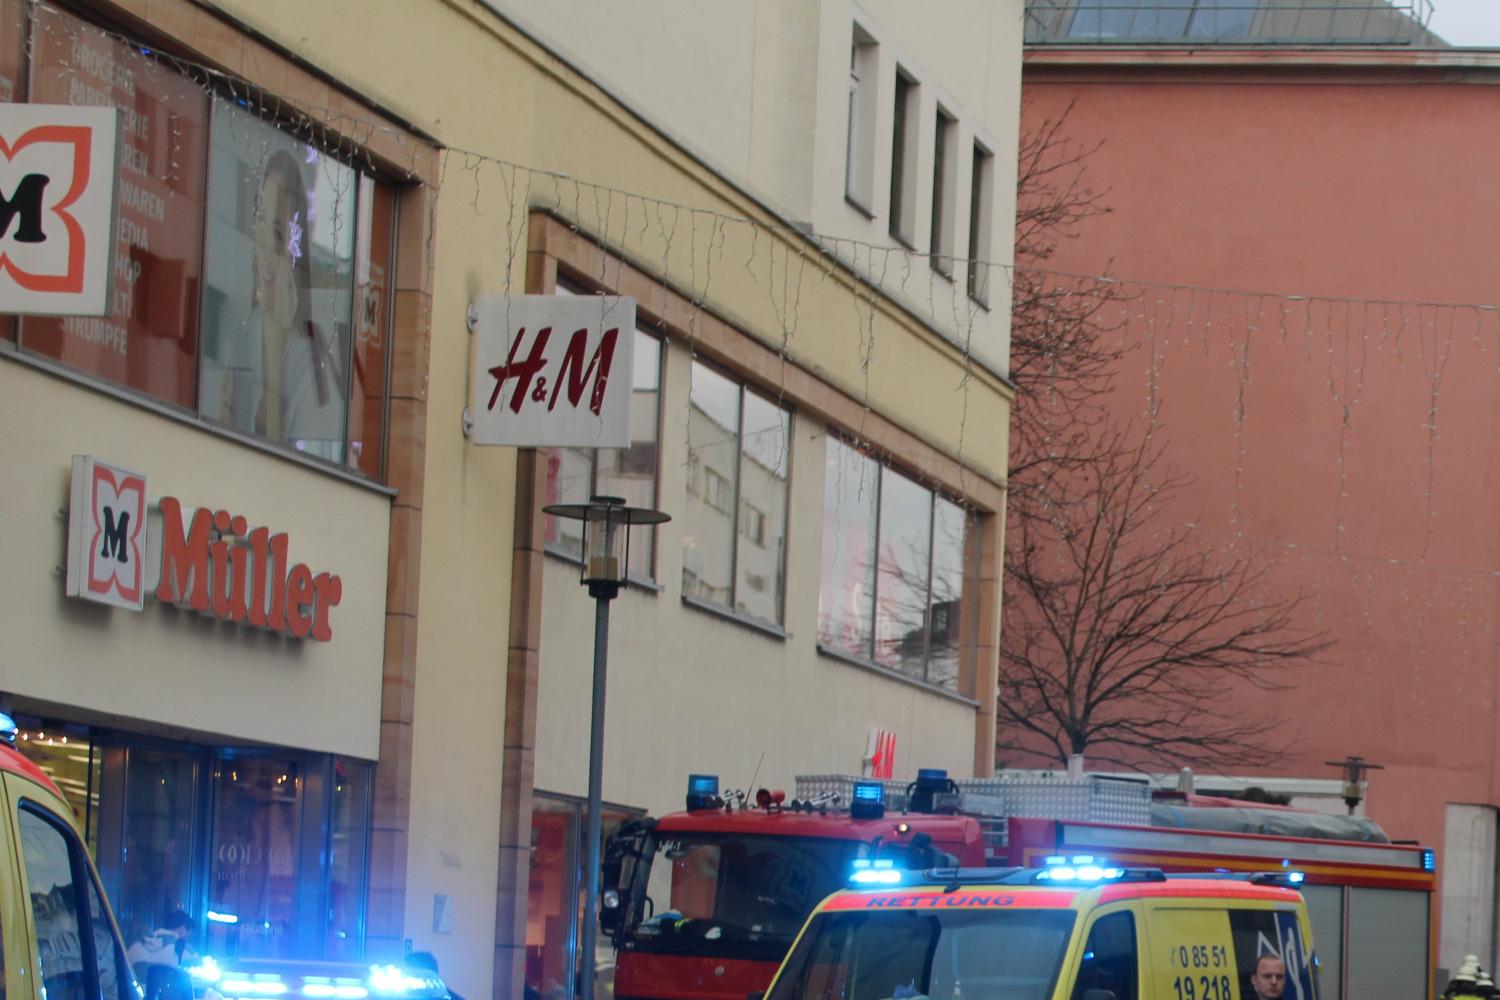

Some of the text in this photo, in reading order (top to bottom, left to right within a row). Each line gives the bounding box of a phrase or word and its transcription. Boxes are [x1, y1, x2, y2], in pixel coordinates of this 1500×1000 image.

[487, 326, 619, 416] H&M
[101, 505, 130, 563] M
[156, 496, 342, 641] Müller
[866, 895, 1015, 908] RETTUNG
